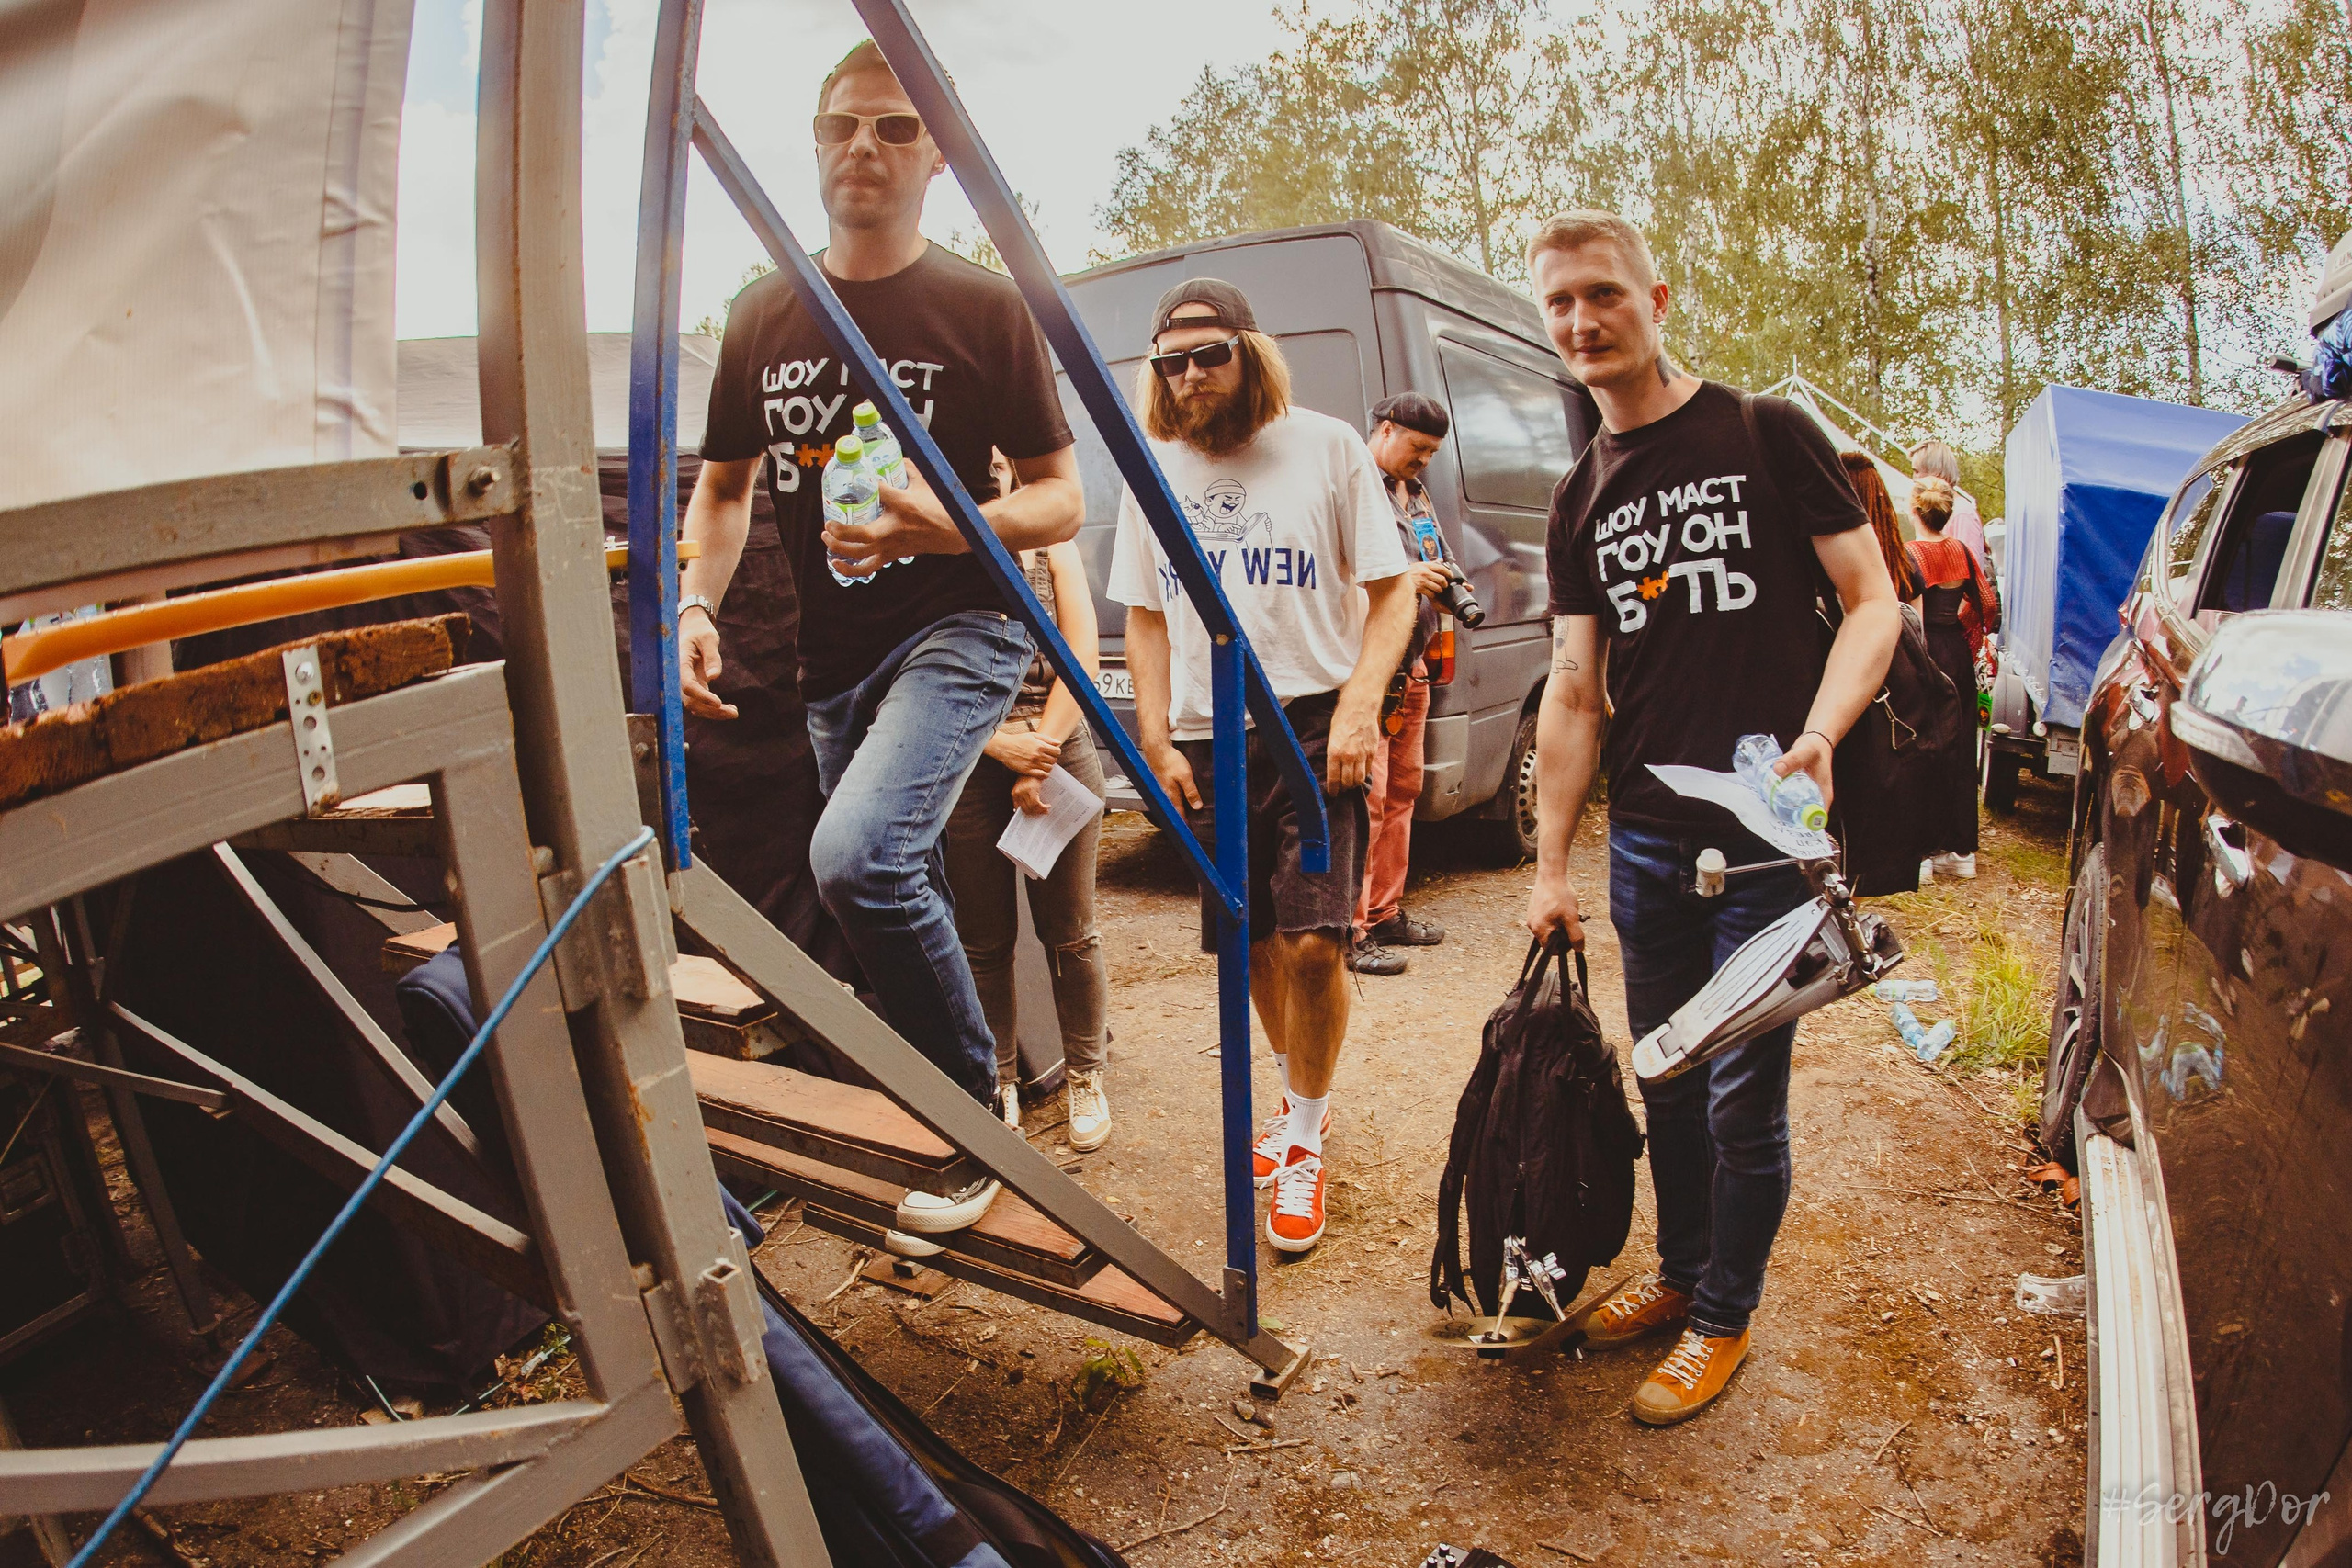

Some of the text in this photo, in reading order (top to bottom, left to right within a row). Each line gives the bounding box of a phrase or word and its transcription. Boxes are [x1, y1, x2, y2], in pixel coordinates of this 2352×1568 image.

[762, 357, 944, 393] ШОУ СТ
[763, 393, 847, 437] ГОУ
[1594, 474, 1747, 543] ШОУ МАСТ
[1596, 510, 1752, 582] ГОУ ОН
